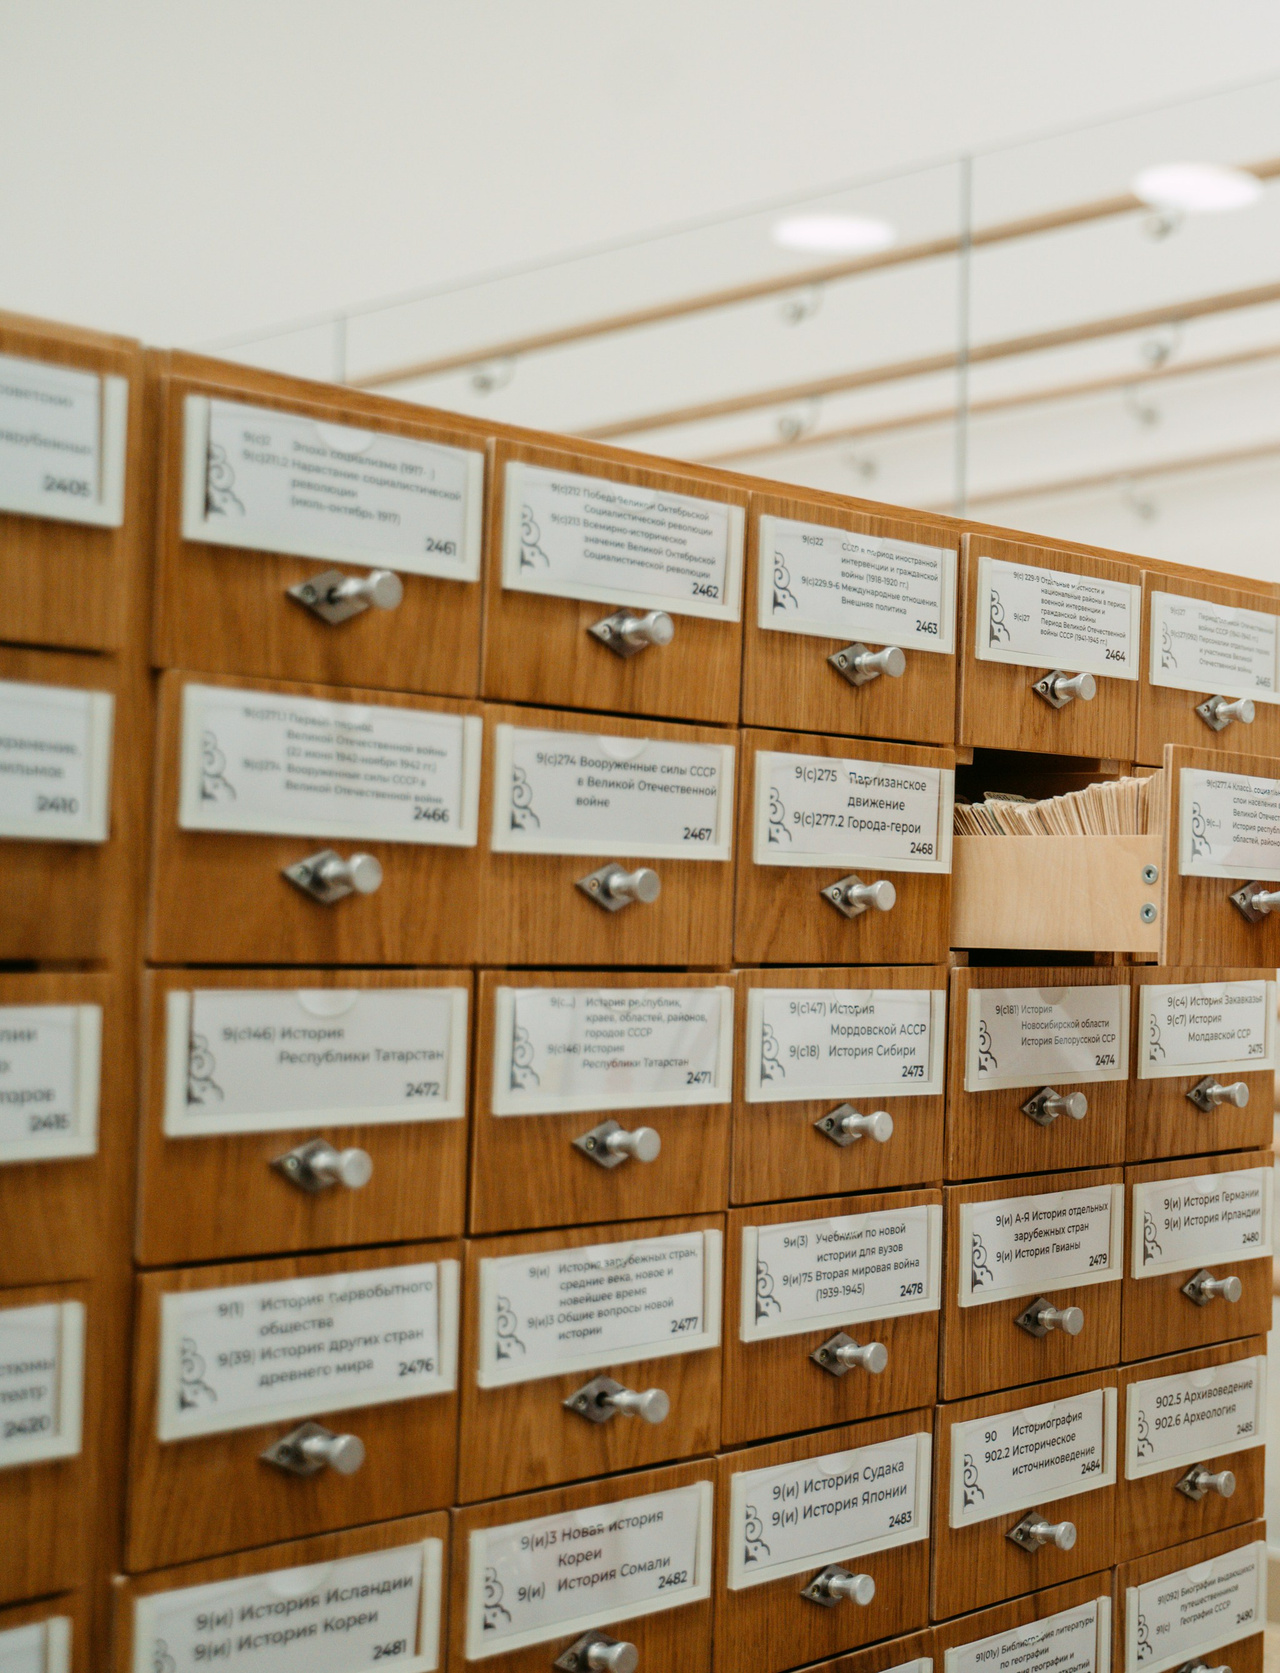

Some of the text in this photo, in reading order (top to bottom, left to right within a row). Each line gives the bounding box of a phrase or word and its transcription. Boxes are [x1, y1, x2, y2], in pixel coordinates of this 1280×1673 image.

[584, 504, 713, 535] Социалистической революции
[425, 537, 456, 555] 2461
[841, 557, 938, 581] интервенции и гражданской
[691, 581, 719, 599] 2462
[841, 596, 906, 615] Внешняя политика
[915, 619, 937, 634] 2463
[1105, 648, 1126, 662] 2464
[536, 752, 716, 777] 9(с)274 Вооруженные силы СССР
[795, 766, 837, 783] 9(с)275
[576, 775, 716, 796] в Великой Отечественной
[575, 795, 610, 807] войне
[847, 796, 905, 811] движение
[413, 805, 449, 823] 2466
[793, 811, 921, 835] 9(с)277.2 Города-герои
[682, 826, 712, 841] 2467
[910, 841, 933, 855] 2468
[789, 1001, 874, 1017] 9(с147) История
[994, 1004, 1052, 1016] 9(с181) История
[1190, 996, 1222, 1007] История
[1021, 1018, 1109, 1030] Новосибирской области
[1188, 1014, 1221, 1025] История
[280, 1027, 344, 1042] История
[585, 1027, 652, 1039] городов СССР
[830, 1023, 926, 1038] Мордовской АССР
[1187, 1028, 1251, 1042] Молдавской ССР
[1021, 1033, 1115, 1047] История Белорусской ССР
[1248, 1043, 1263, 1054] 2475
[278, 1048, 444, 1066] Республики Татарстан
[789, 1043, 915, 1060] 9(с18) История Сибири
[1095, 1054, 1115, 1066] 2474
[582, 1057, 689, 1070] Республики Татарстан
[901, 1064, 924, 1077] 2473
[686, 1070, 711, 1085] 2471
[405, 1081, 440, 1097] 2472
[1163, 1189, 1259, 1212] 9(и) История Германии
[995, 1203, 1108, 1227] 9(и) А-Я История отдельных
[1163, 1208, 1260, 1231] 9(и) История Ирландии
[783, 1234, 808, 1248] 9и(3)
[865, 1228, 876, 1237] по
[878, 1223, 906, 1236] новой
[1014, 1223, 1089, 1242] зарубежных стран
[1242, 1231, 1258, 1244] 2480
[816, 1243, 903, 1262] истории для вузов
[995, 1241, 1080, 1263] 9(и) История Гвианы
[1088, 1252, 1107, 1266] 2479
[782, 1258, 919, 1287] 9(и)75 Вторая мировая война
[559, 1287, 646, 1306] новейшее время
[815, 1282, 865, 1302] (1939-1945)
[900, 1281, 923, 1297] 2478
[557, 1311, 595, 1323] Общие
[596, 1305, 641, 1318] вопросы
[644, 1297, 673, 1310] новой
[259, 1317, 333, 1336] общества
[558, 1326, 602, 1340] истории
[670, 1316, 698, 1333] 2477
[260, 1342, 324, 1360] История
[328, 1335, 379, 1352] других
[383, 1329, 423, 1344] стран
[258, 1359, 373, 1387] древнего мира
[398, 1358, 433, 1377] 2476
[1155, 1379, 1252, 1408] 902.5 Архивоведение
[1154, 1404, 1236, 1430] 902.6 Археология
[984, 1411, 1082, 1443] 90 Историография
[1236, 1421, 1252, 1435] 2485
[984, 1432, 1076, 1463] 902.2 Историческое
[1012, 1446, 1095, 1476] источниковедение
[1081, 1458, 1100, 1474] 2484
[772, 1461, 904, 1502] 9(и) История Судака
[771, 1484, 907, 1528] 9(и) История Японии
[888, 1510, 912, 1528] 2483
[520, 1530, 557, 1551] 9(и)3
[607, 1510, 663, 1532] история
[557, 1548, 602, 1567] Кореи
[516, 1556, 670, 1602] 9(и) История Сомали
[657, 1570, 687, 1589] 2482
[195, 1577, 412, 1631] 9(и) История Исландии
[1236, 1608, 1252, 1624] 2490
[193, 1611, 378, 1661] 9(и) История Кореи
[373, 1639, 406, 1660] 2481
[1000, 1647, 1049, 1669] по географии
